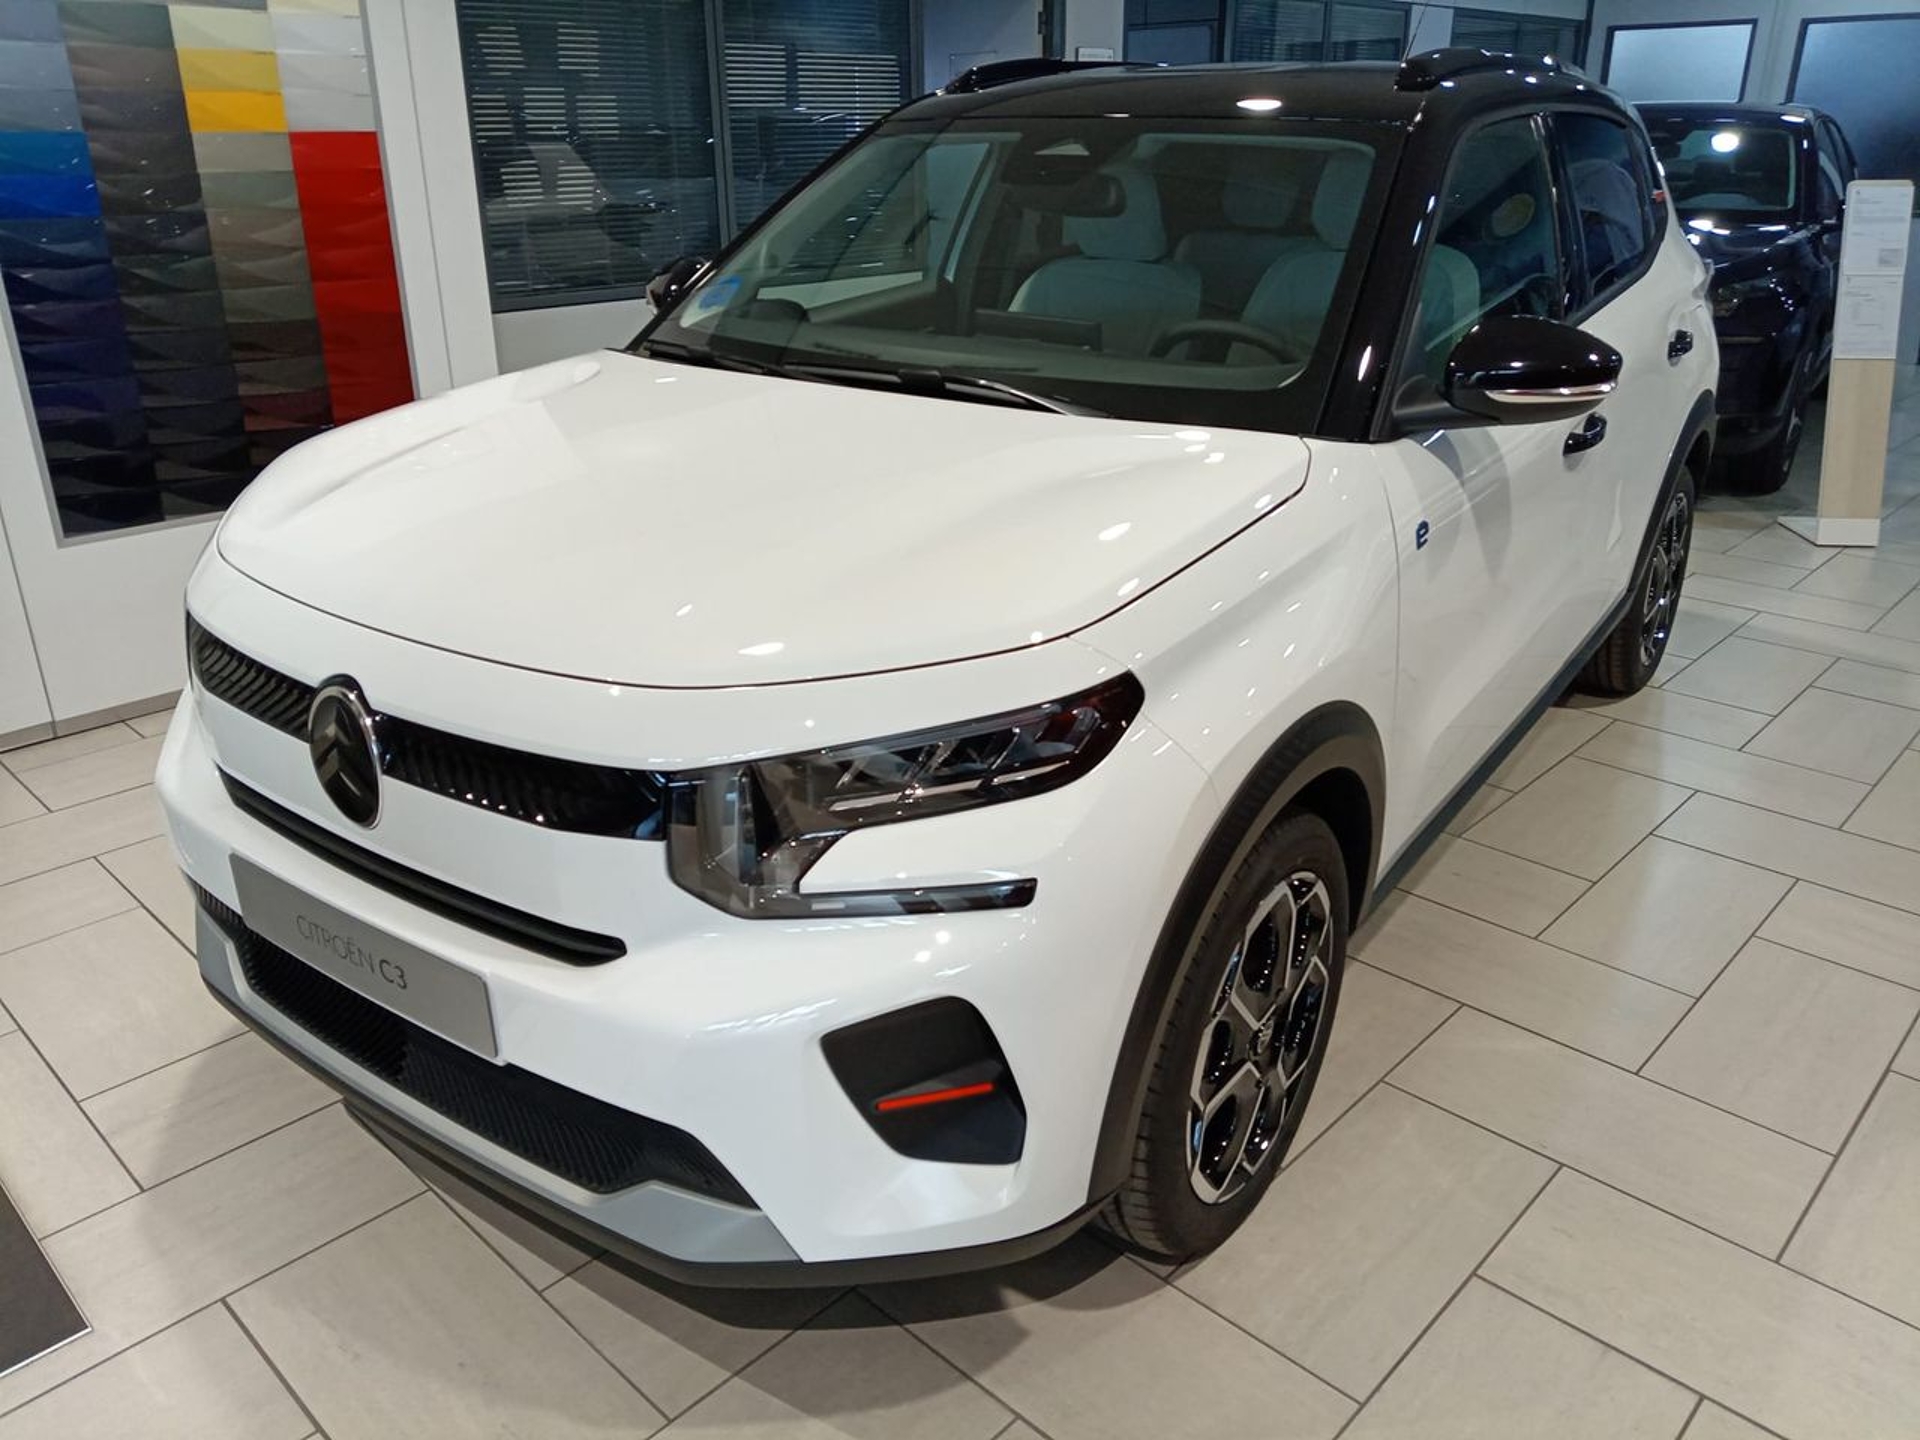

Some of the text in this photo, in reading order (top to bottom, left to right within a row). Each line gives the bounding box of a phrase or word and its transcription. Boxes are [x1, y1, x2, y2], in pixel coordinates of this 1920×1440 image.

[1415, 519, 1430, 551] e
[296, 914, 408, 990] CITROËN C3
